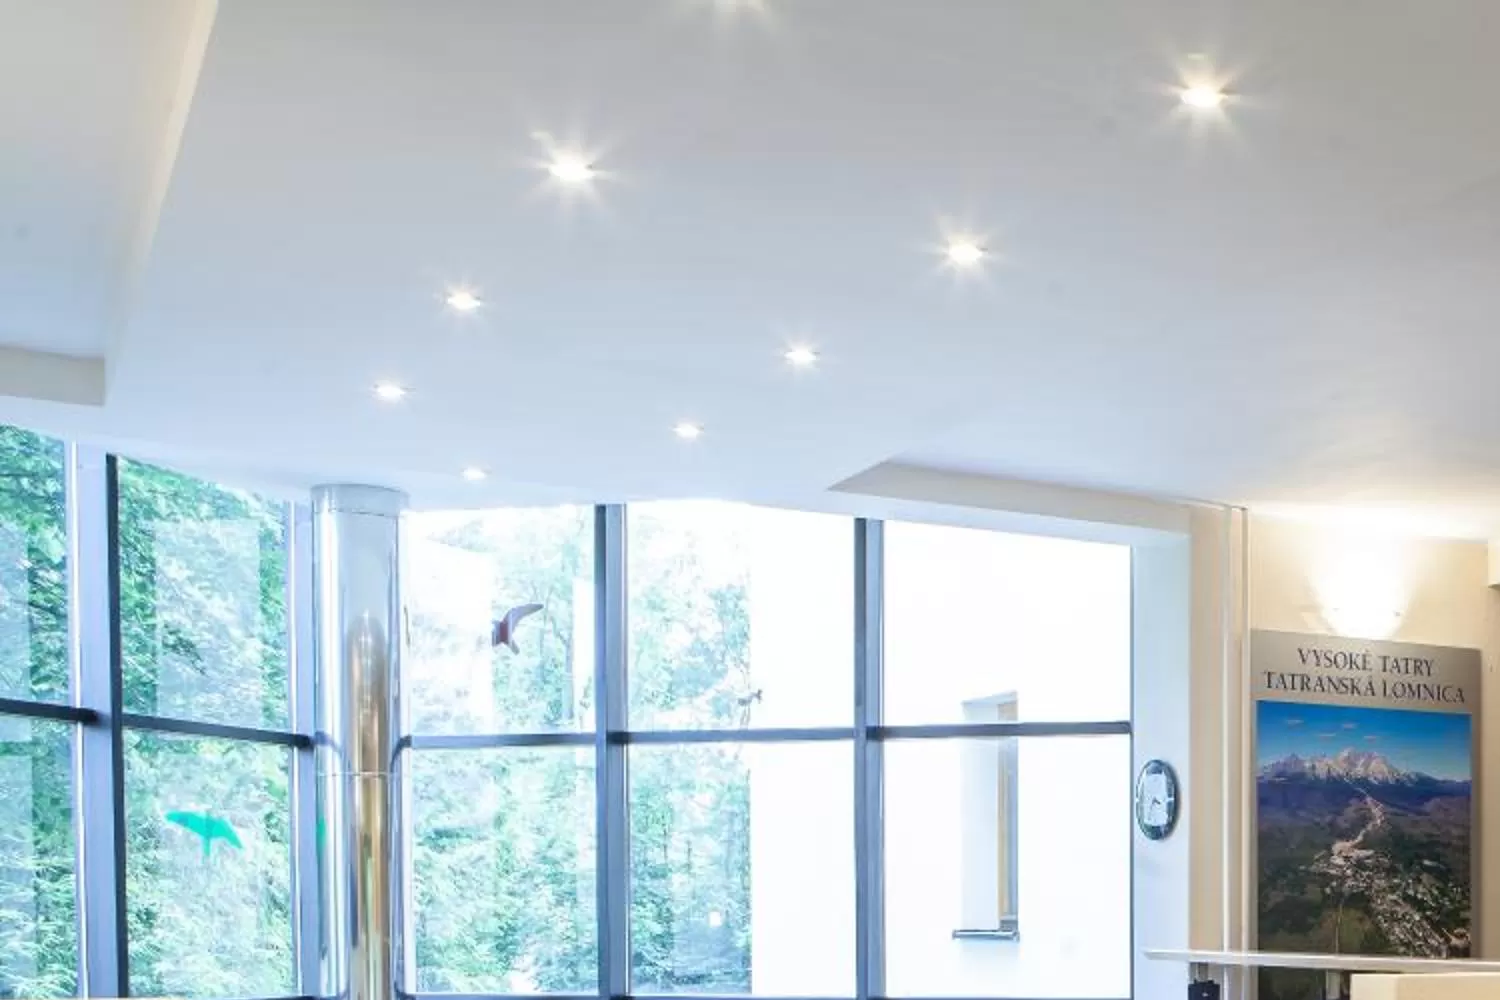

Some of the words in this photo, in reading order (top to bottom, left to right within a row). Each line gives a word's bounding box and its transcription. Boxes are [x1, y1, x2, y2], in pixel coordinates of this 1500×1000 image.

[1297, 647, 1373, 672] VYSOKÉ
[1381, 655, 1435, 677] TATRY
[1264, 671, 1376, 698] TATRANSKÁ
[1383, 681, 1465, 704] LOMNICA
